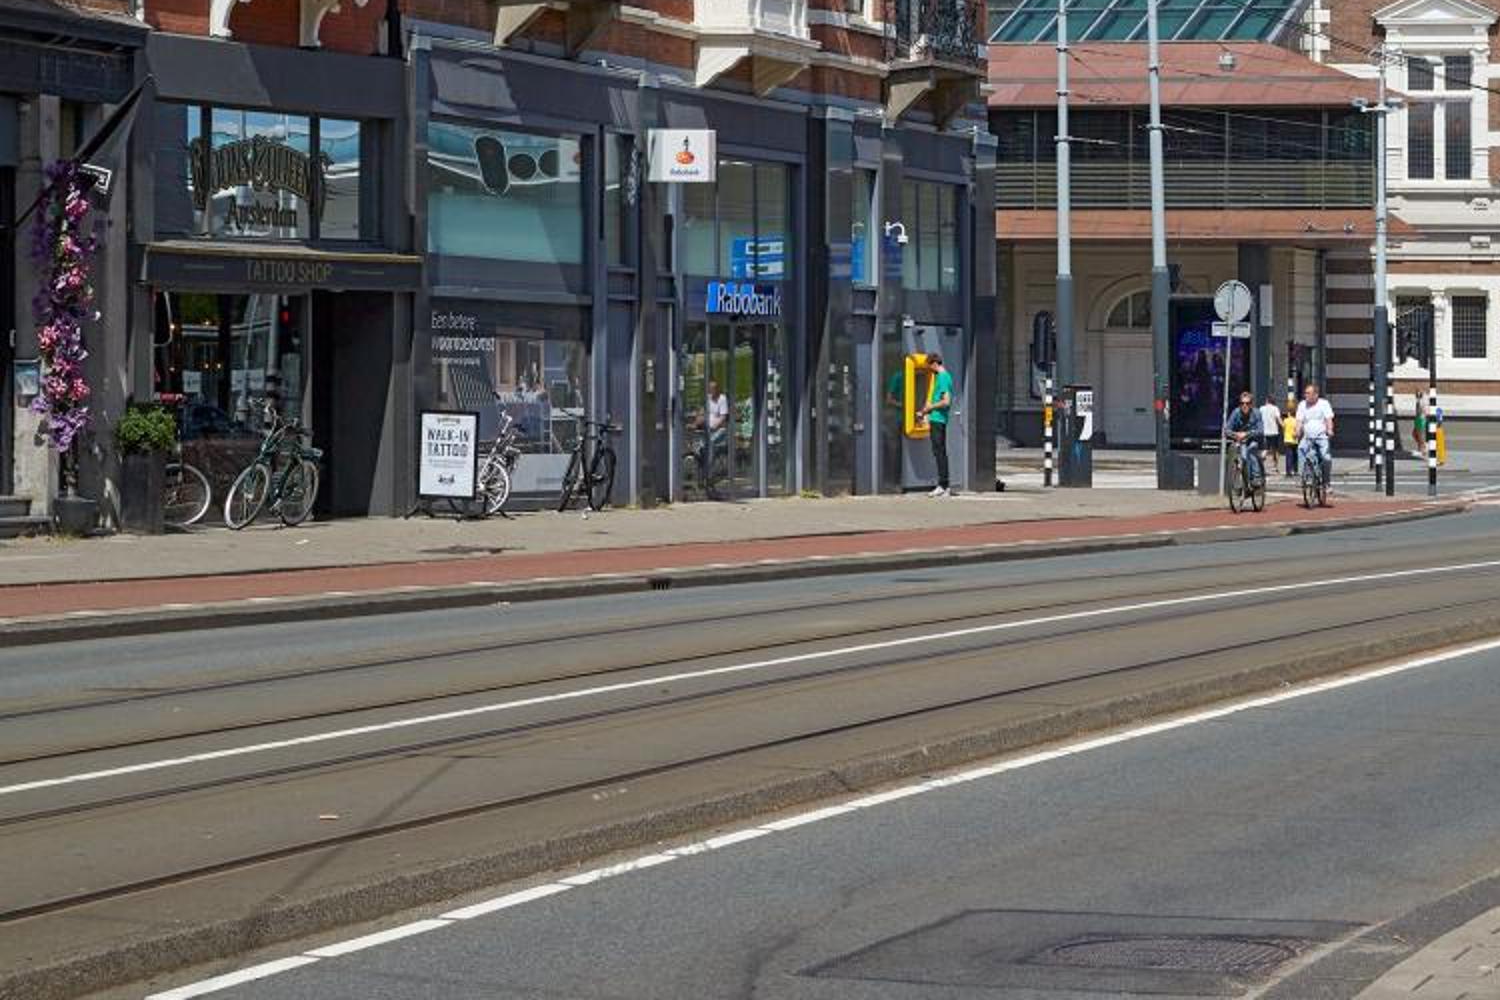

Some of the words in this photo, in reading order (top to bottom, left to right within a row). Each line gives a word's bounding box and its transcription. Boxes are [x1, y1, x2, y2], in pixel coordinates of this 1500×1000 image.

[246, 260, 295, 282] TATTOO
[299, 262, 333, 282] SHOP
[716, 283, 781, 316] Rabobank
[427, 429, 469, 442] WALK-IN
[427, 442, 468, 457] TATTOO
